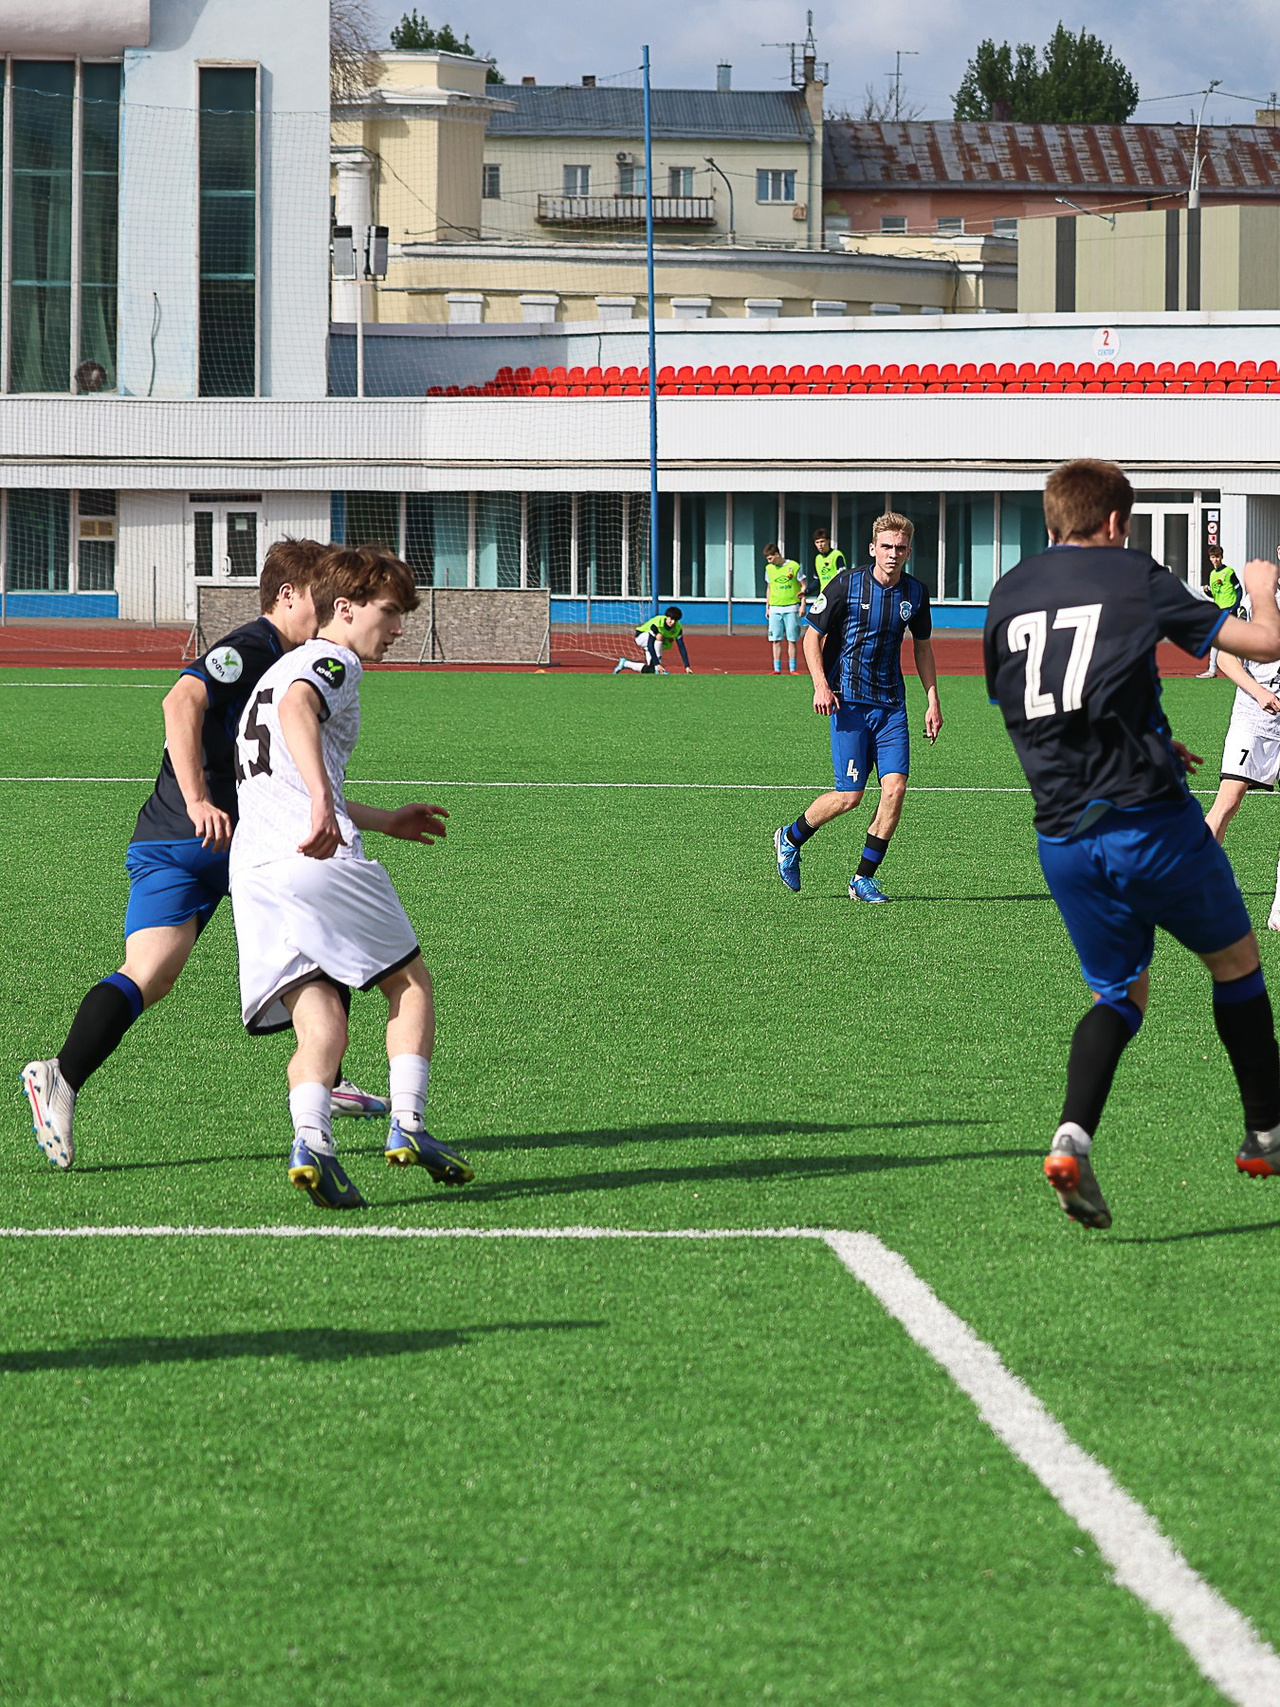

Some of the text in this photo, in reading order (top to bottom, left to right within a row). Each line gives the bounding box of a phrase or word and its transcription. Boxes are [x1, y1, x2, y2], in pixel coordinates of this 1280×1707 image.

[1103, 330, 1109, 346] 2
[1007, 604, 1102, 720] 27
[234, 688, 274, 790] 5
[1239, 749, 1250, 766] 7
[846, 758, 860, 783] 4
